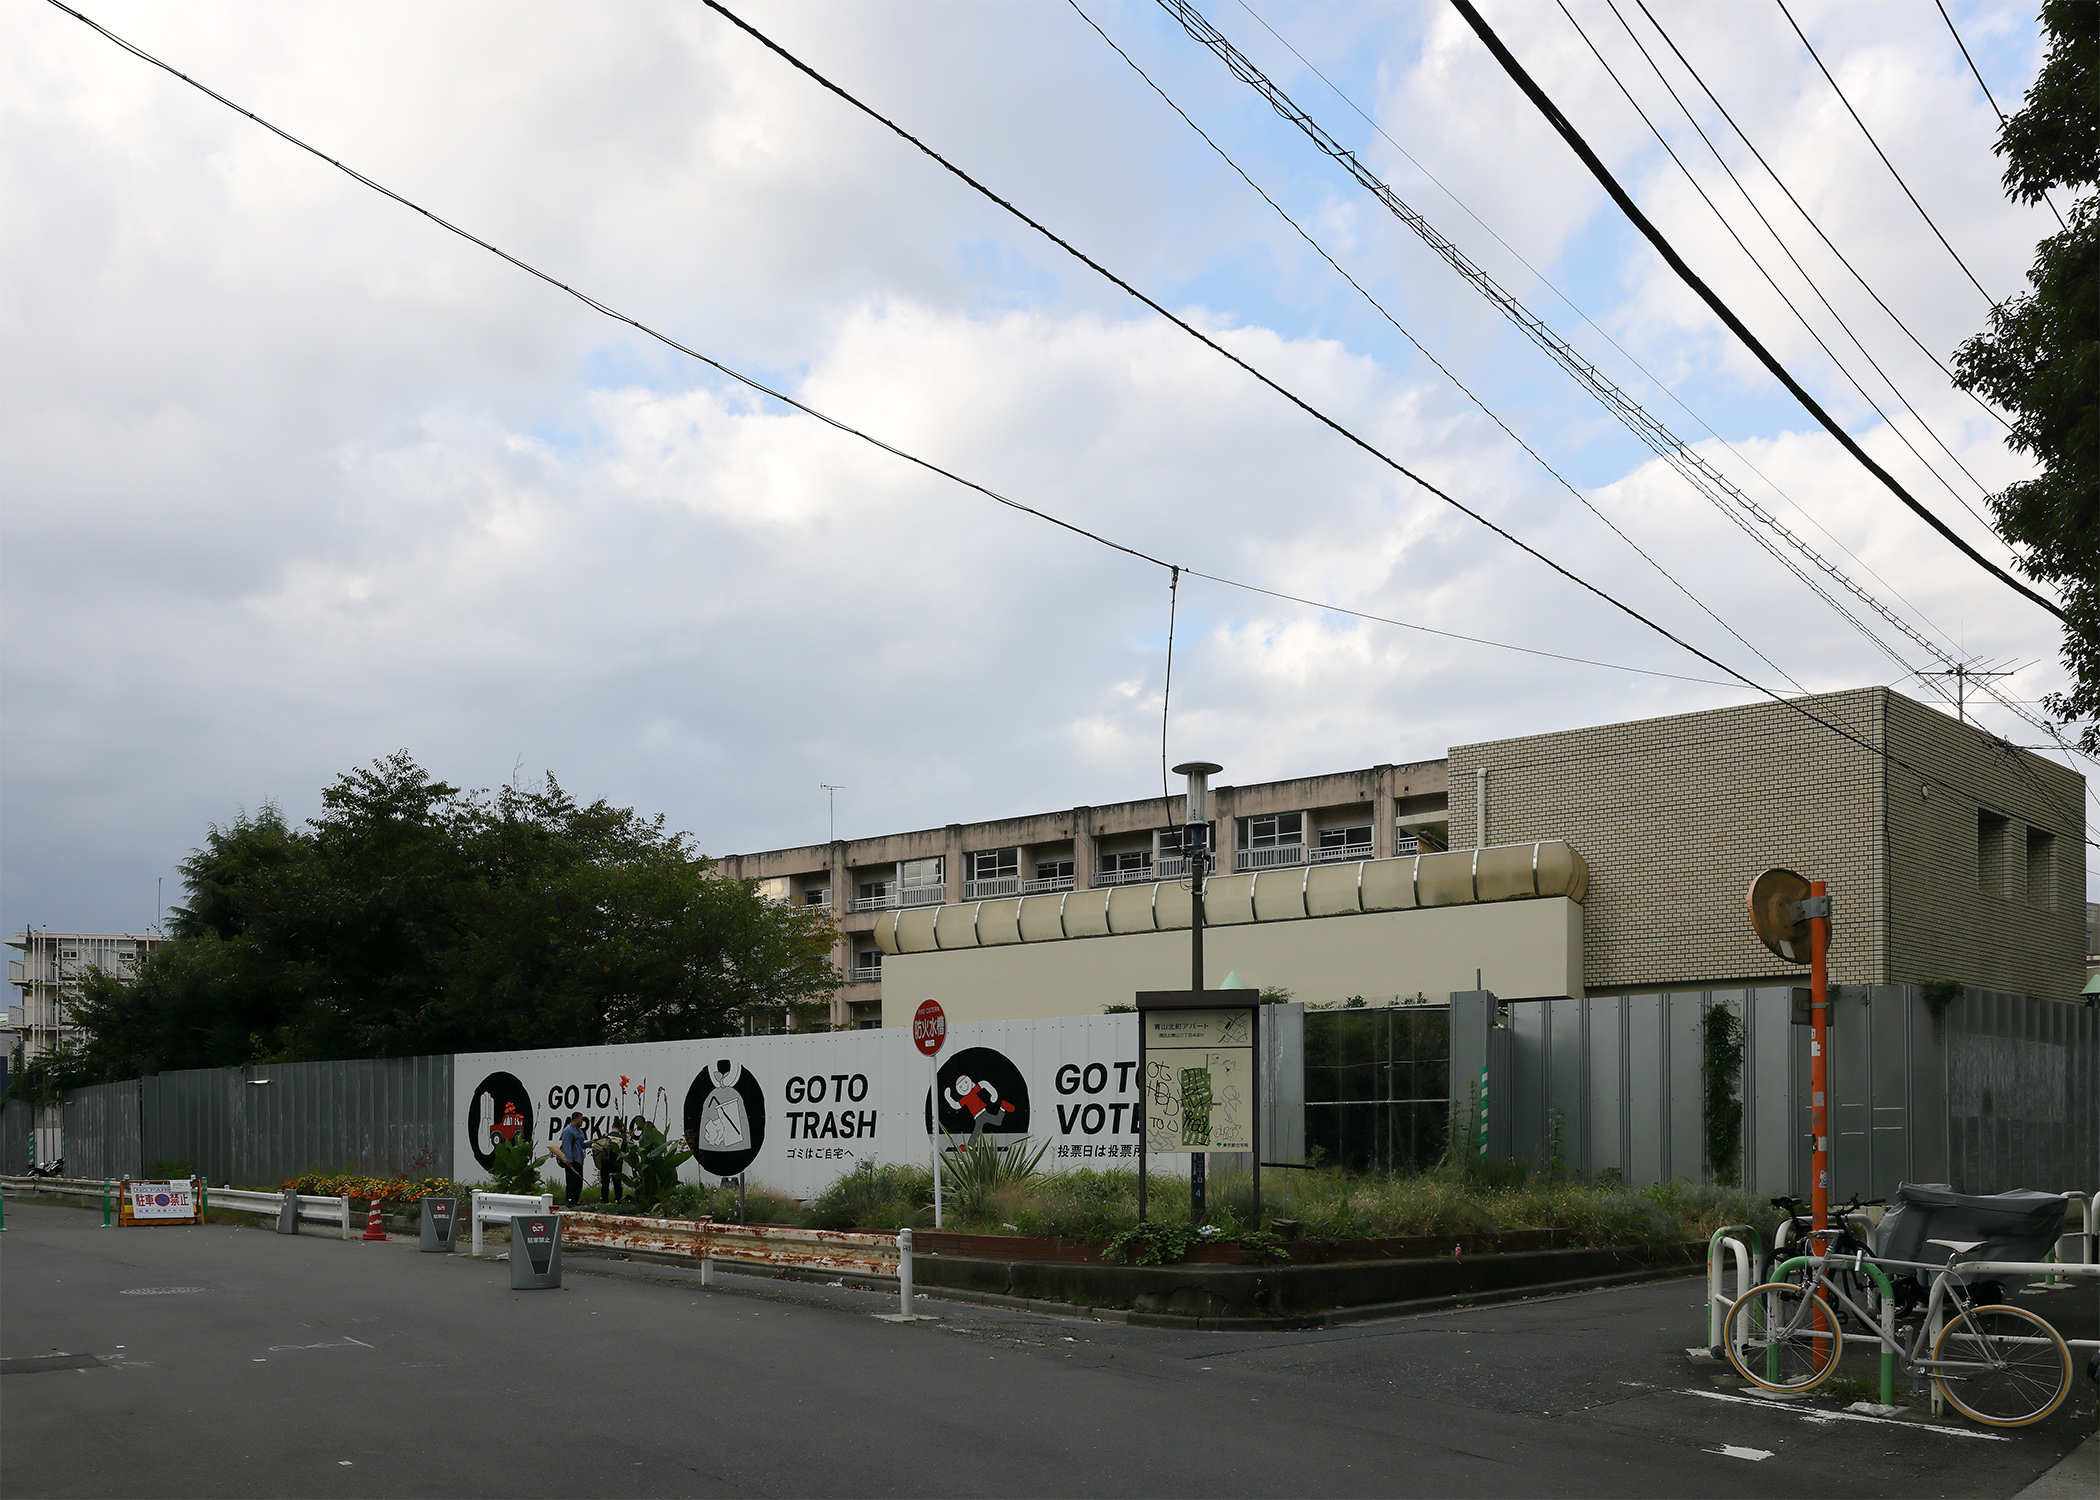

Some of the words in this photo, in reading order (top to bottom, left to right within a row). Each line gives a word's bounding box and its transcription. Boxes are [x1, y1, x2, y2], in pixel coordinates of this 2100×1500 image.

[914, 1016, 945, 1039] 防火水槽
[1154, 1022, 1209, 1030] 青山北町アパート
[785, 1075, 827, 1104] GO
[830, 1073, 868, 1102] TO
[1055, 1063, 1108, 1095] GO
[1113, 1061, 1140, 1093] T
[548, 1084, 580, 1110] GO
[583, 1083, 611, 1109] TO
[786, 1110, 877, 1139] TRASH
[786, 1147, 854, 1159] ゴミはご自宅へ
[135, 1193, 154, 1207] 駐車
[170, 1193, 190, 1207] 禁止
[1195, 1189, 1202, 1197] 4
